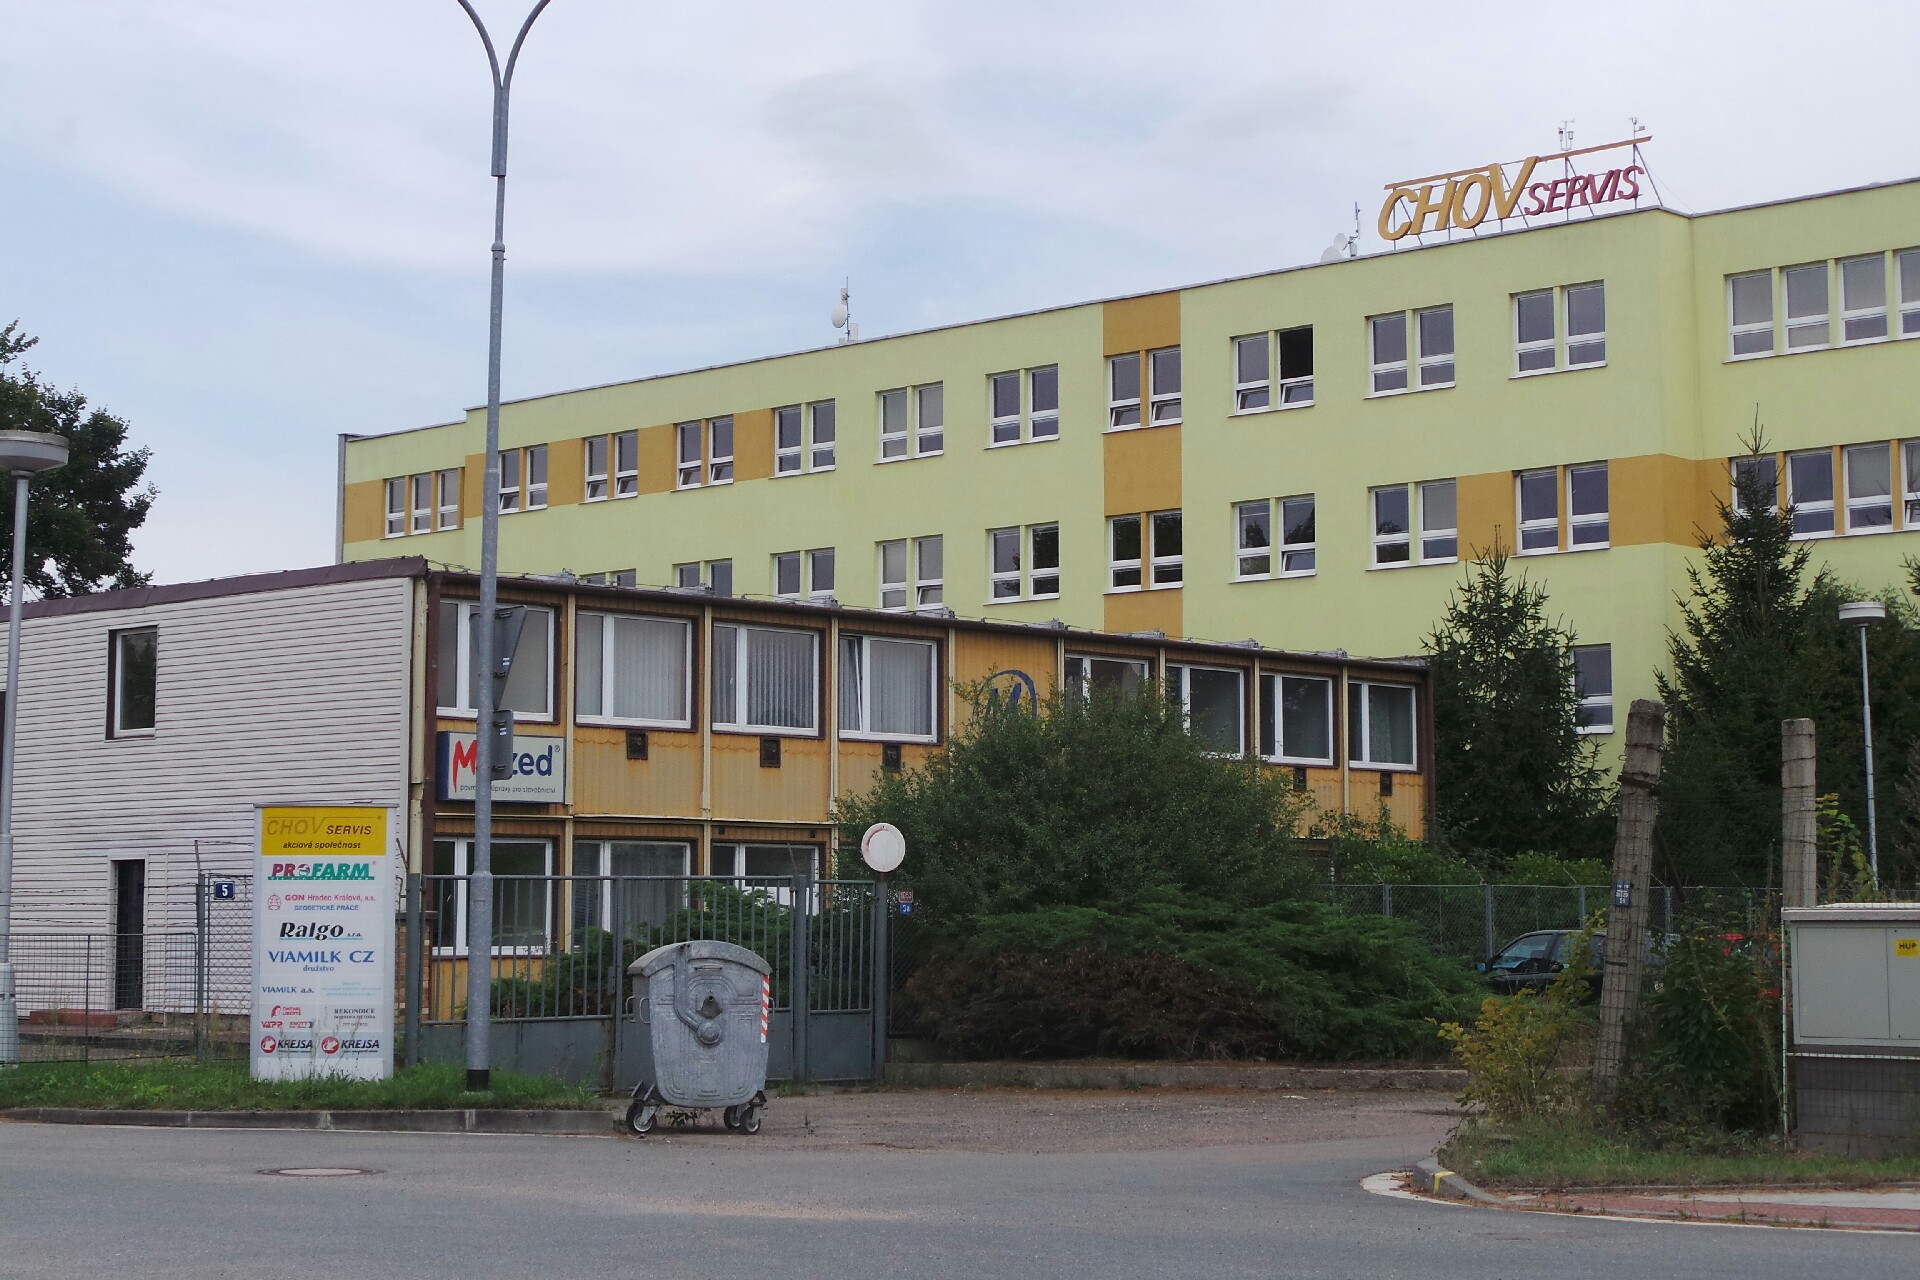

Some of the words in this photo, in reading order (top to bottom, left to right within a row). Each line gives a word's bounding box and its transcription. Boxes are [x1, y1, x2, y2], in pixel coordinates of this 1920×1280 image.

[1378, 156, 1541, 240] CHOV
[1524, 165, 1645, 216] SERVIS
[267, 817, 326, 836] CHOV
[326, 825, 372, 835] SERVIS
[283, 841, 312, 849] akciová
[315, 841, 361, 850] společnost
[271, 863, 370, 878] PROFARM
[221, 884, 229, 897] 5
[280, 922, 344, 941] Ralgo
[1898, 942, 1917, 950] HUP
[268, 950, 342, 963] VIAMILK
[349, 950, 375, 963] CZ
[303, 964, 334, 972] družstvo
[261, 986, 297, 994] VIAMILK
[277, 1039, 313, 1049] KREJSA
[341, 1039, 380, 1049] KREJSA
